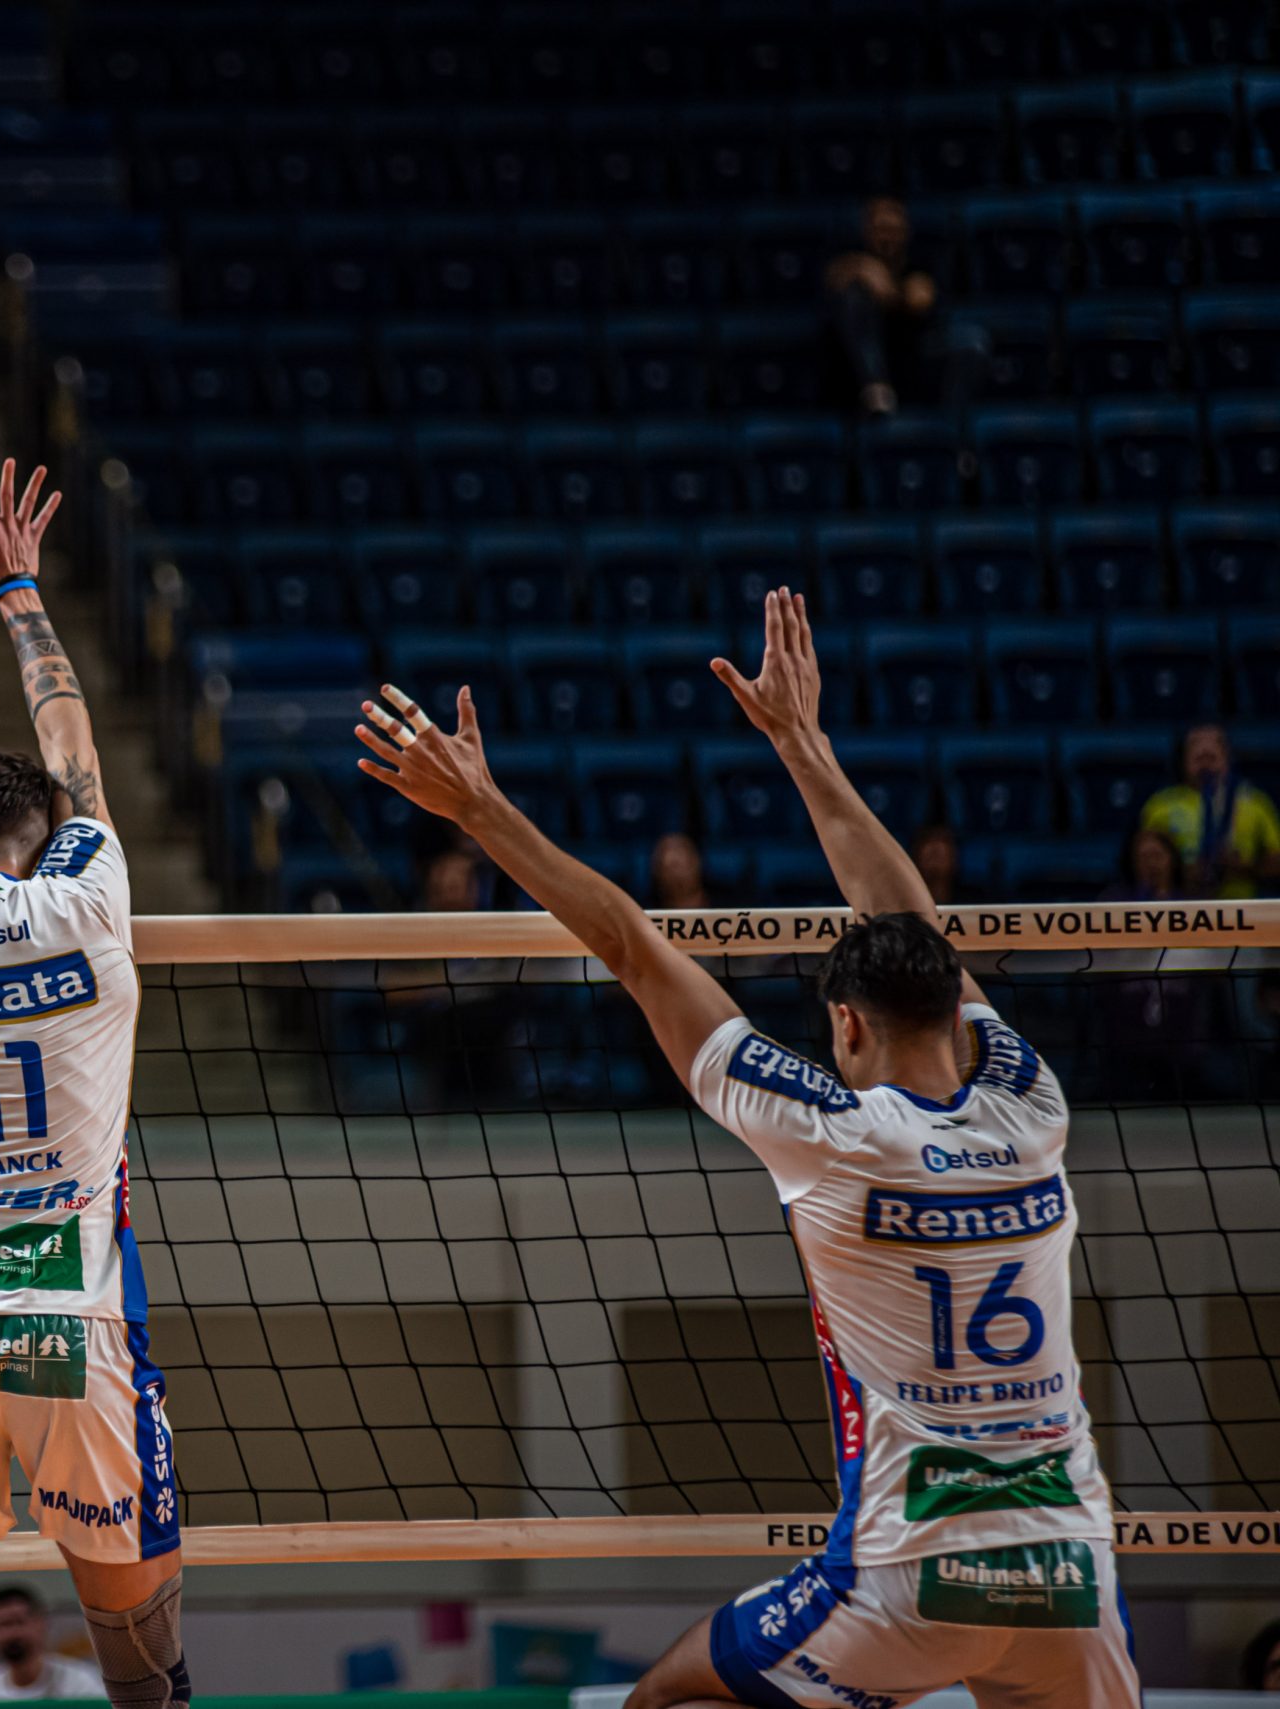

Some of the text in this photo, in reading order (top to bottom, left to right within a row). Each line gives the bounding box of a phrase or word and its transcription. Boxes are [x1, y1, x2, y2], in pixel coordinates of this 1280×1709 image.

[979, 913, 1022, 936] DE
[1034, 909, 1255, 935] VOLLEYBALL
[922, 1144, 1020, 1173] betsul
[874, 1193, 1061, 1238] Renata
[914, 1262, 1045, 1370] 16
[897, 1373, 1064, 1404] FELIPE BRITO
[38, 1488, 134, 1528] MAJIPACK
[1166, 1522, 1211, 1545] DE
[937, 1558, 1045, 1586] Unimed
